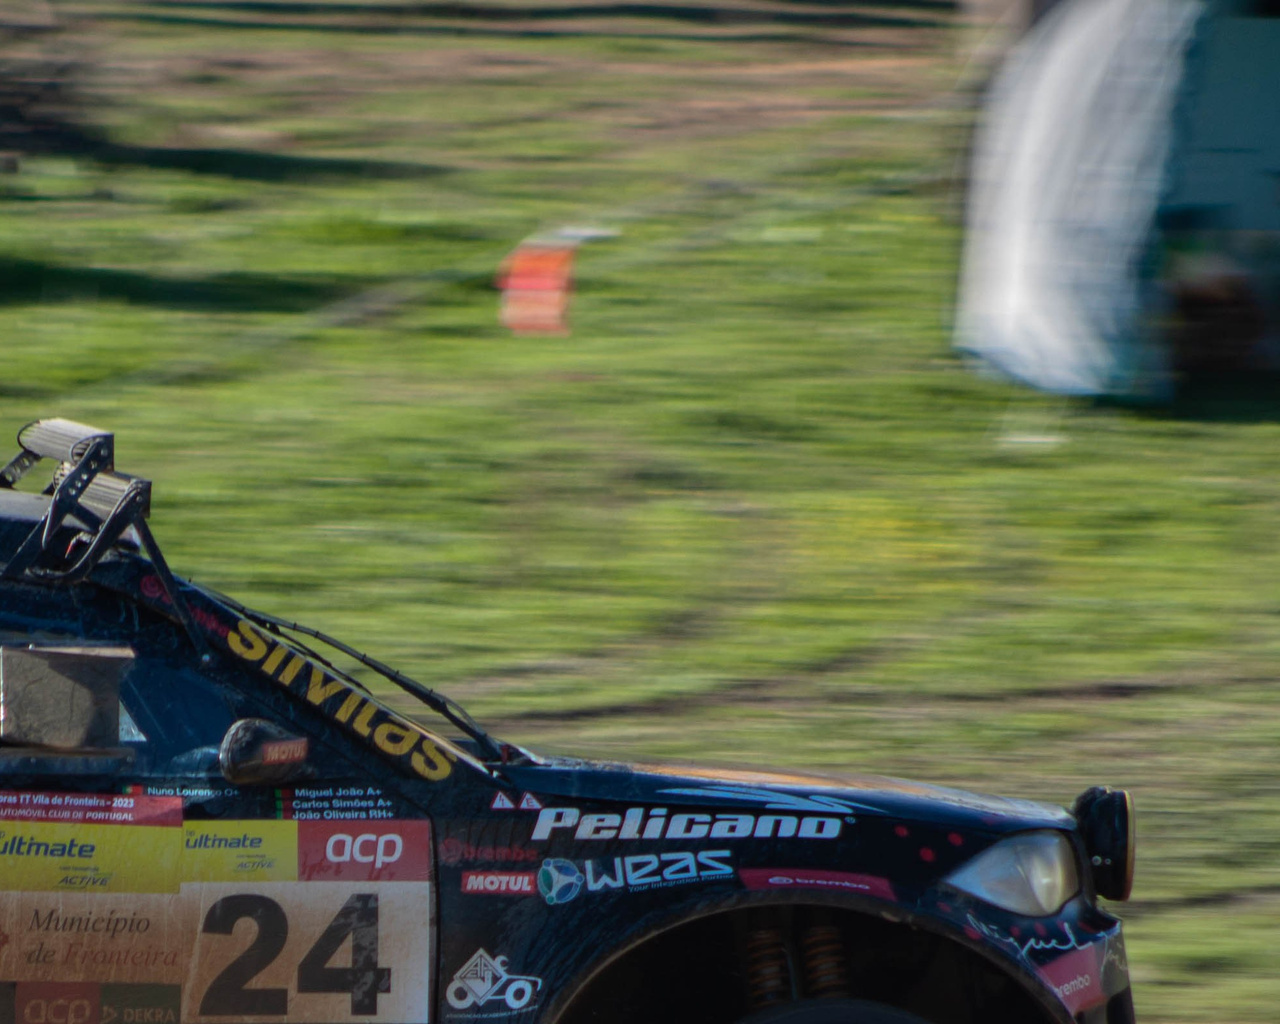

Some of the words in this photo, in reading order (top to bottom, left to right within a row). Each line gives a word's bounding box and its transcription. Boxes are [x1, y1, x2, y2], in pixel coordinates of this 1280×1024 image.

[147, 786, 174, 796] Nuno
[295, 788, 333, 799] Miguel
[336, 788, 364, 797] João
[366, 787, 382, 796] A+
[20, 794, 30, 803] TT
[32, 794, 49, 804] Vila
[51, 795, 62, 805] de
[65, 797, 106, 807] Fronteira
[112, 797, 134, 808] 2023
[292, 800, 329, 809] Carlos
[332, 799, 374, 808] Simões
[377, 798, 393, 808] A+
[48, 809, 70, 818] CLUB
[72, 810, 83, 819] DE
[85, 812, 134, 821] PORTUGAL
[292, 810, 320, 820] João
[323, 810, 367, 820] Oliveira
[369, 809, 394, 819] RH+
[531, 807, 843, 841] Pelicano
[185, 833, 263, 849] ultimate
[326, 833, 403, 869] acp
[58, 875, 109, 887] ACTIVE
[466, 875, 531, 892] MOTUL
[628, 884, 649, 893] Your
[651, 878, 699, 889] Integration
[28, 909, 150, 938] Município
[25, 942, 56, 965] de
[63, 942, 178, 967] Fronteira
[199, 893, 391, 1016] 24
[124, 1008, 176, 1024] DEKRA
